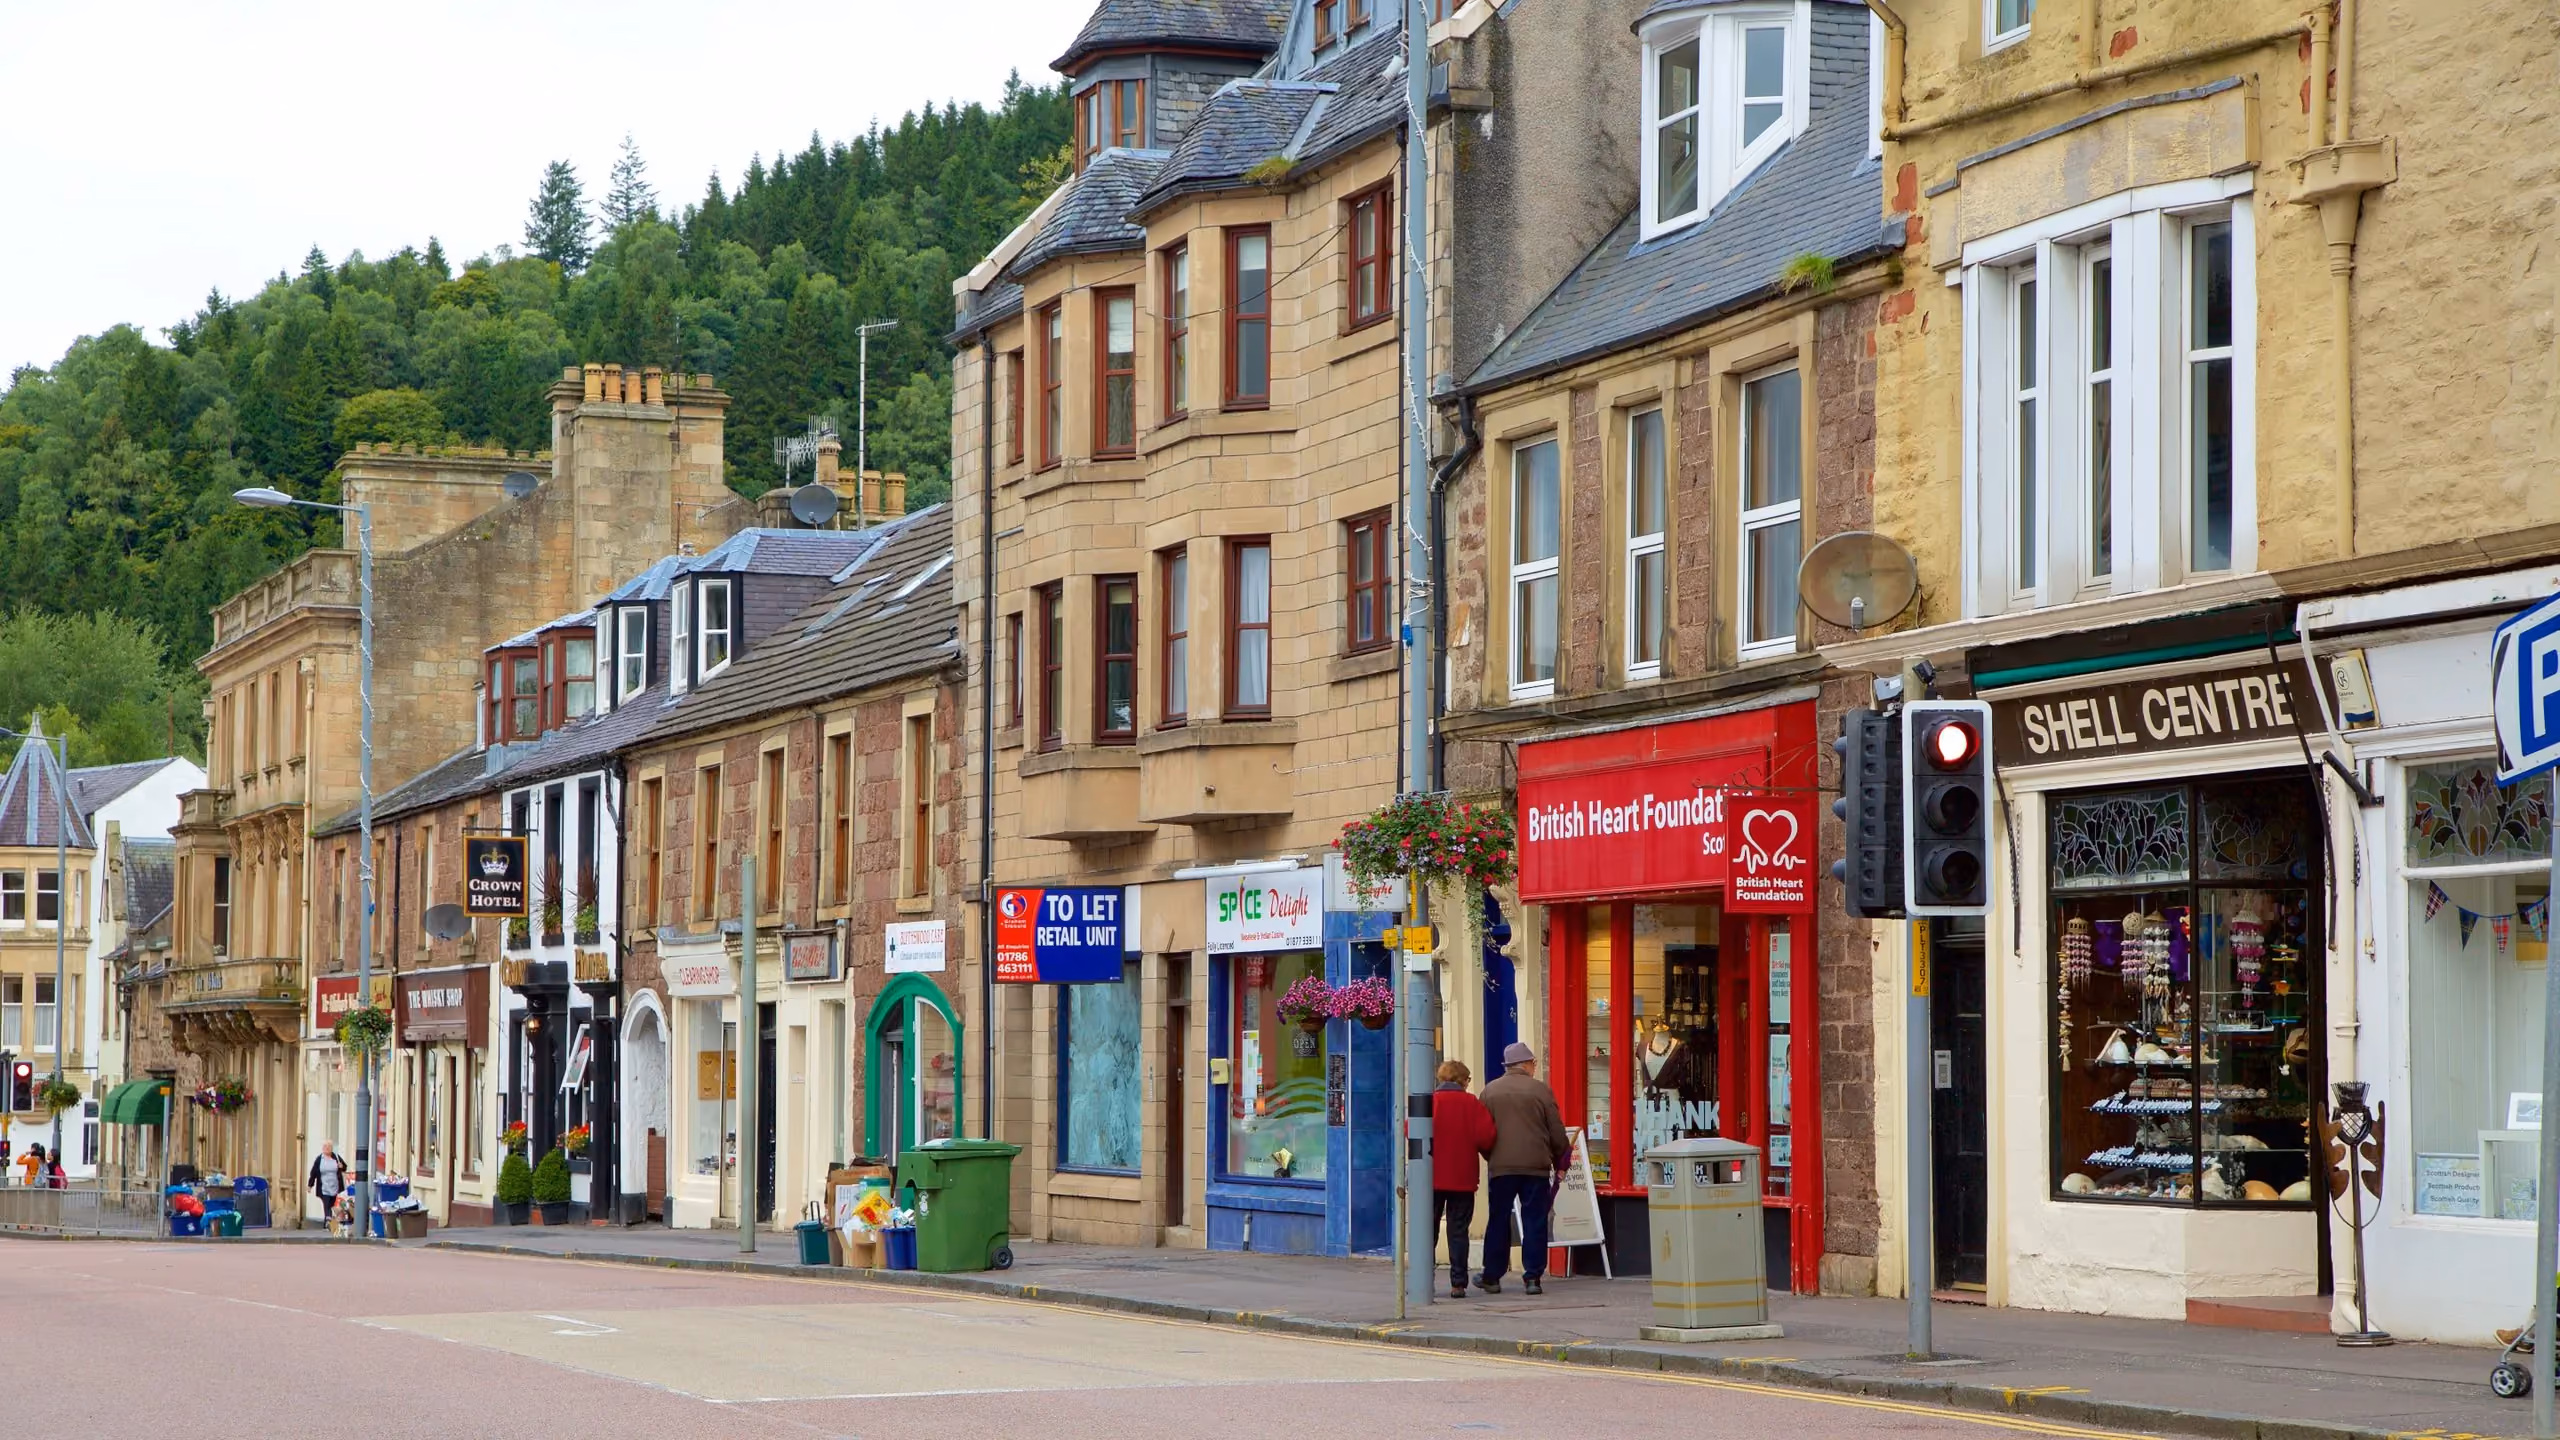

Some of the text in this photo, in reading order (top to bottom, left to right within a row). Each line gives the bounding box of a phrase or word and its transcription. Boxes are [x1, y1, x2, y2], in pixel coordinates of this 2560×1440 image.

[2532, 630, 2560, 738] P
[2024, 672, 2294, 754] SHELL CENTRE
[1528, 783, 1753, 842] British Heart Foundat
[469, 878, 522, 892] CROWN
[1736, 876, 1803, 888] British Heart
[471, 894, 521, 907] HOTEL
[1219, 881, 1309, 927] SPICE Delight
[1736, 889, 1804, 901] Foundation
[1046, 894, 1118, 922] TO LET
[1037, 926, 1118, 947] RETAIL UNIT
[997, 951, 1028, 962] 01786
[997, 963, 1033, 973] 463111
[408, 990, 421, 1008] THE
[421, 988, 445, 1008] WHISKY
[446, 987, 463, 1007] SHOP
[1634, 1098, 1720, 1130] THANK
